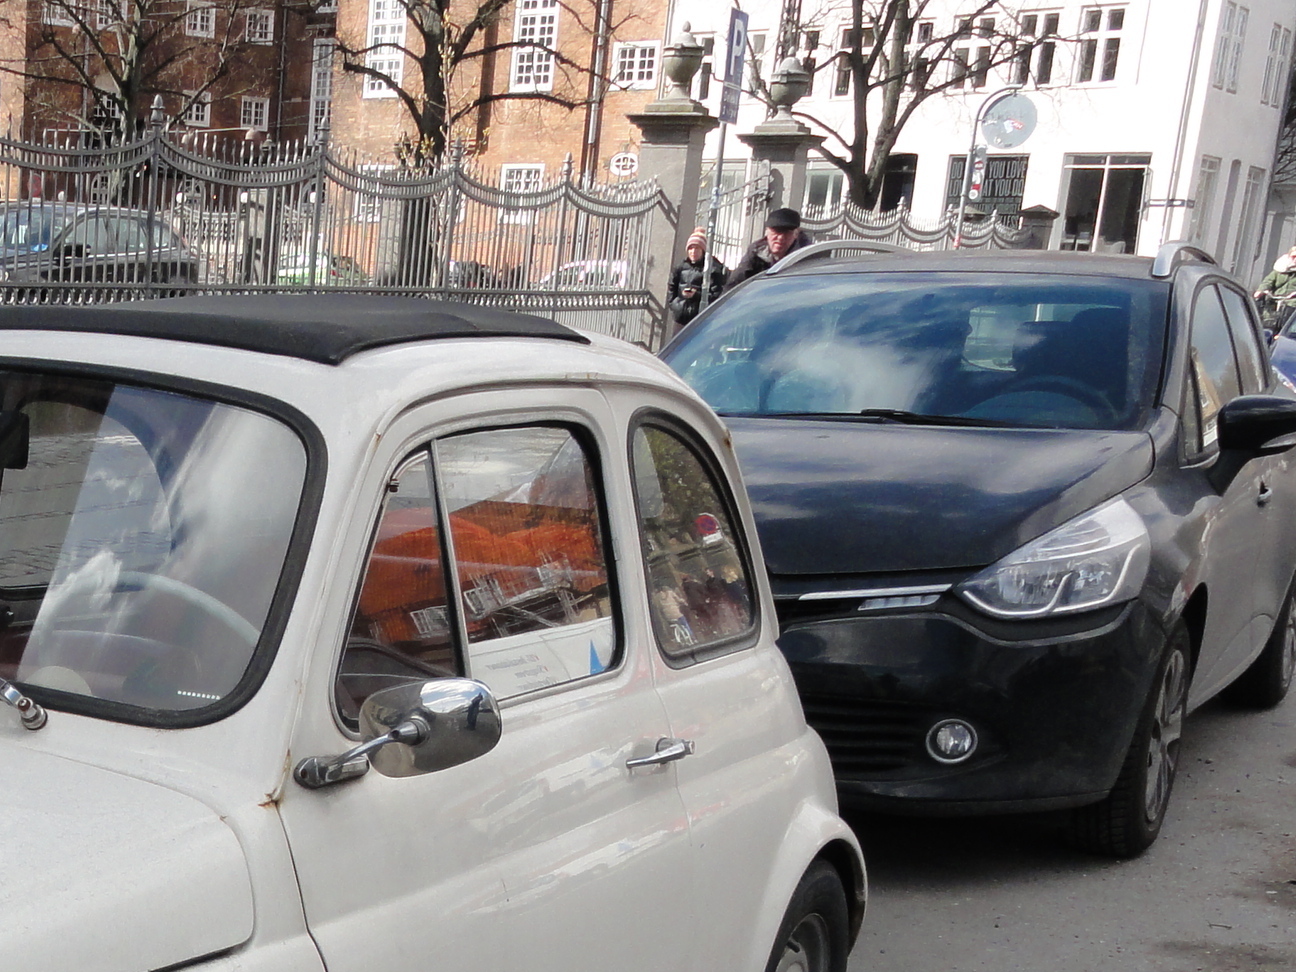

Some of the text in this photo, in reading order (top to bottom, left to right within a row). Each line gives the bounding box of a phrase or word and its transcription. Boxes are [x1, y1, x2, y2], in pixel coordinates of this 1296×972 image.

[730, 18, 745, 76] P
[988, 160, 1005, 179] YOU
[1005, 160, 1028, 179] LOVE
[994, 179, 1012, 197] YOU
